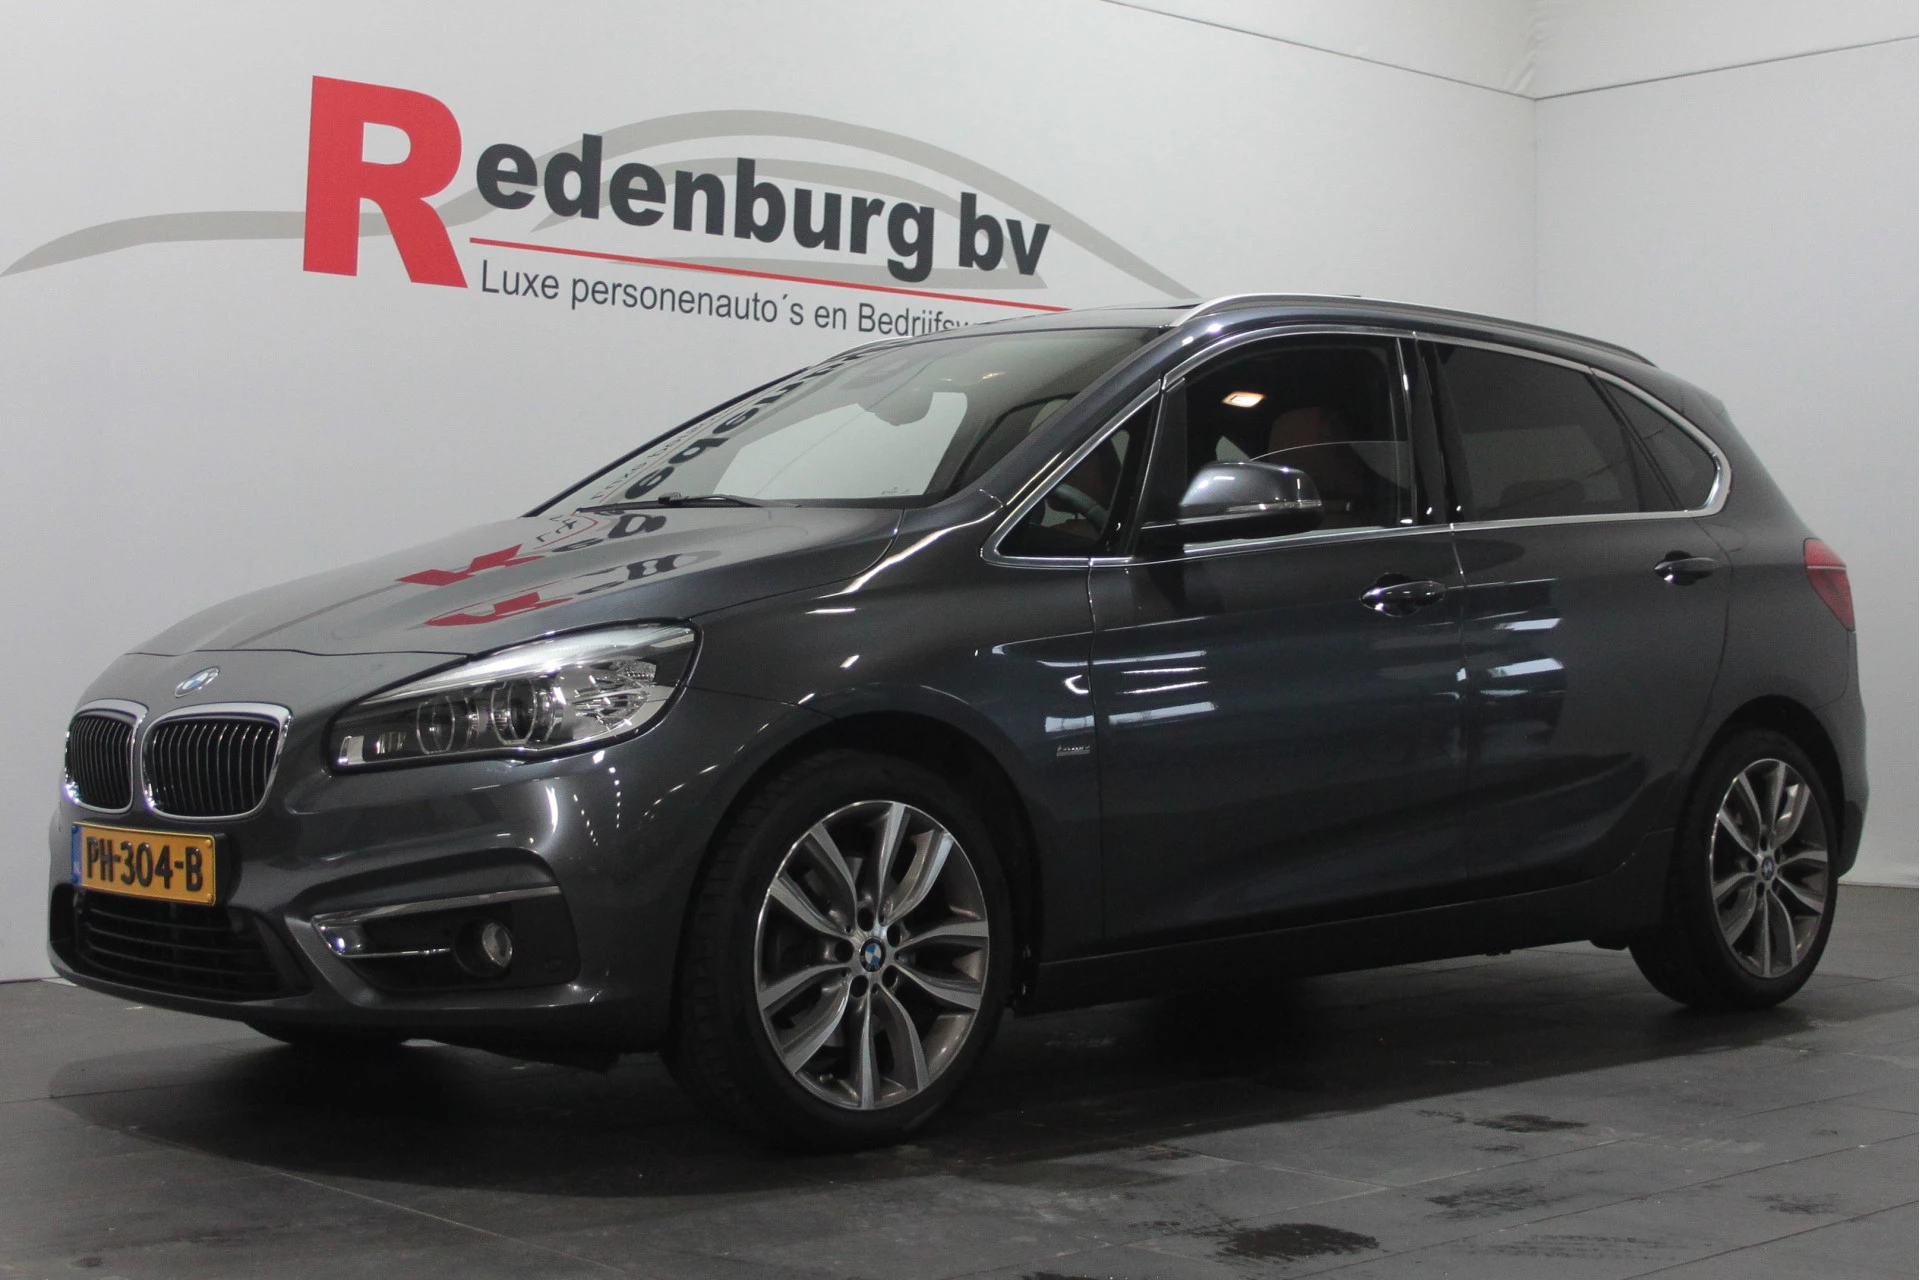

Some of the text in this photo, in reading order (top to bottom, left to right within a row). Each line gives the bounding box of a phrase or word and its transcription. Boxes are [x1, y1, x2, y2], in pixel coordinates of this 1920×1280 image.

[303, 75, 1050, 288] Redenburg bv
[481, 259, 560, 300] Luxe
[814, 304, 847, 330] en
[858, 303, 968, 337] Bedrijf
[86, 836, 204, 892] PH-304-B
